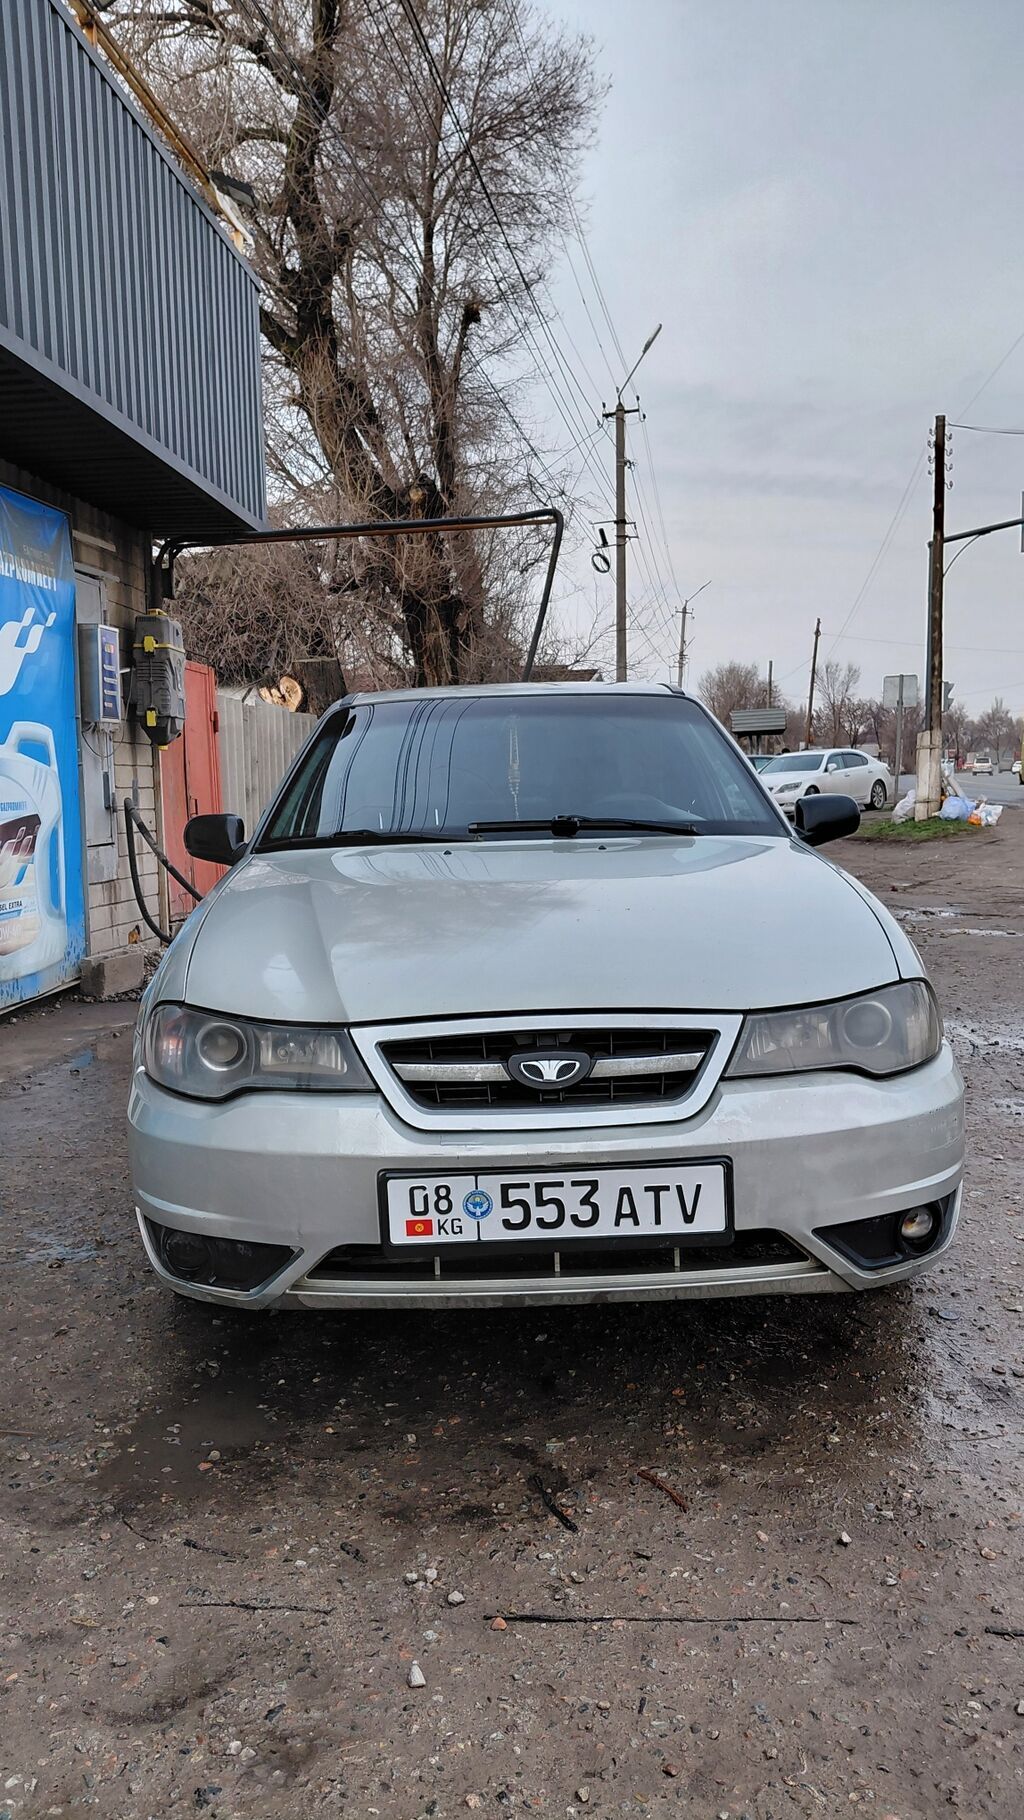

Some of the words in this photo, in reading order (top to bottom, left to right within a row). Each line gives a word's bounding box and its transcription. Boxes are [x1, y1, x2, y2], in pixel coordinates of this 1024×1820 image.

[8, 900, 23, 910] EXTRA
[408, 1184, 453, 1216] 08
[500, 1179, 600, 1231] 553
[614, 1183, 702, 1227] ATV
[437, 1217, 463, 1236] KG
